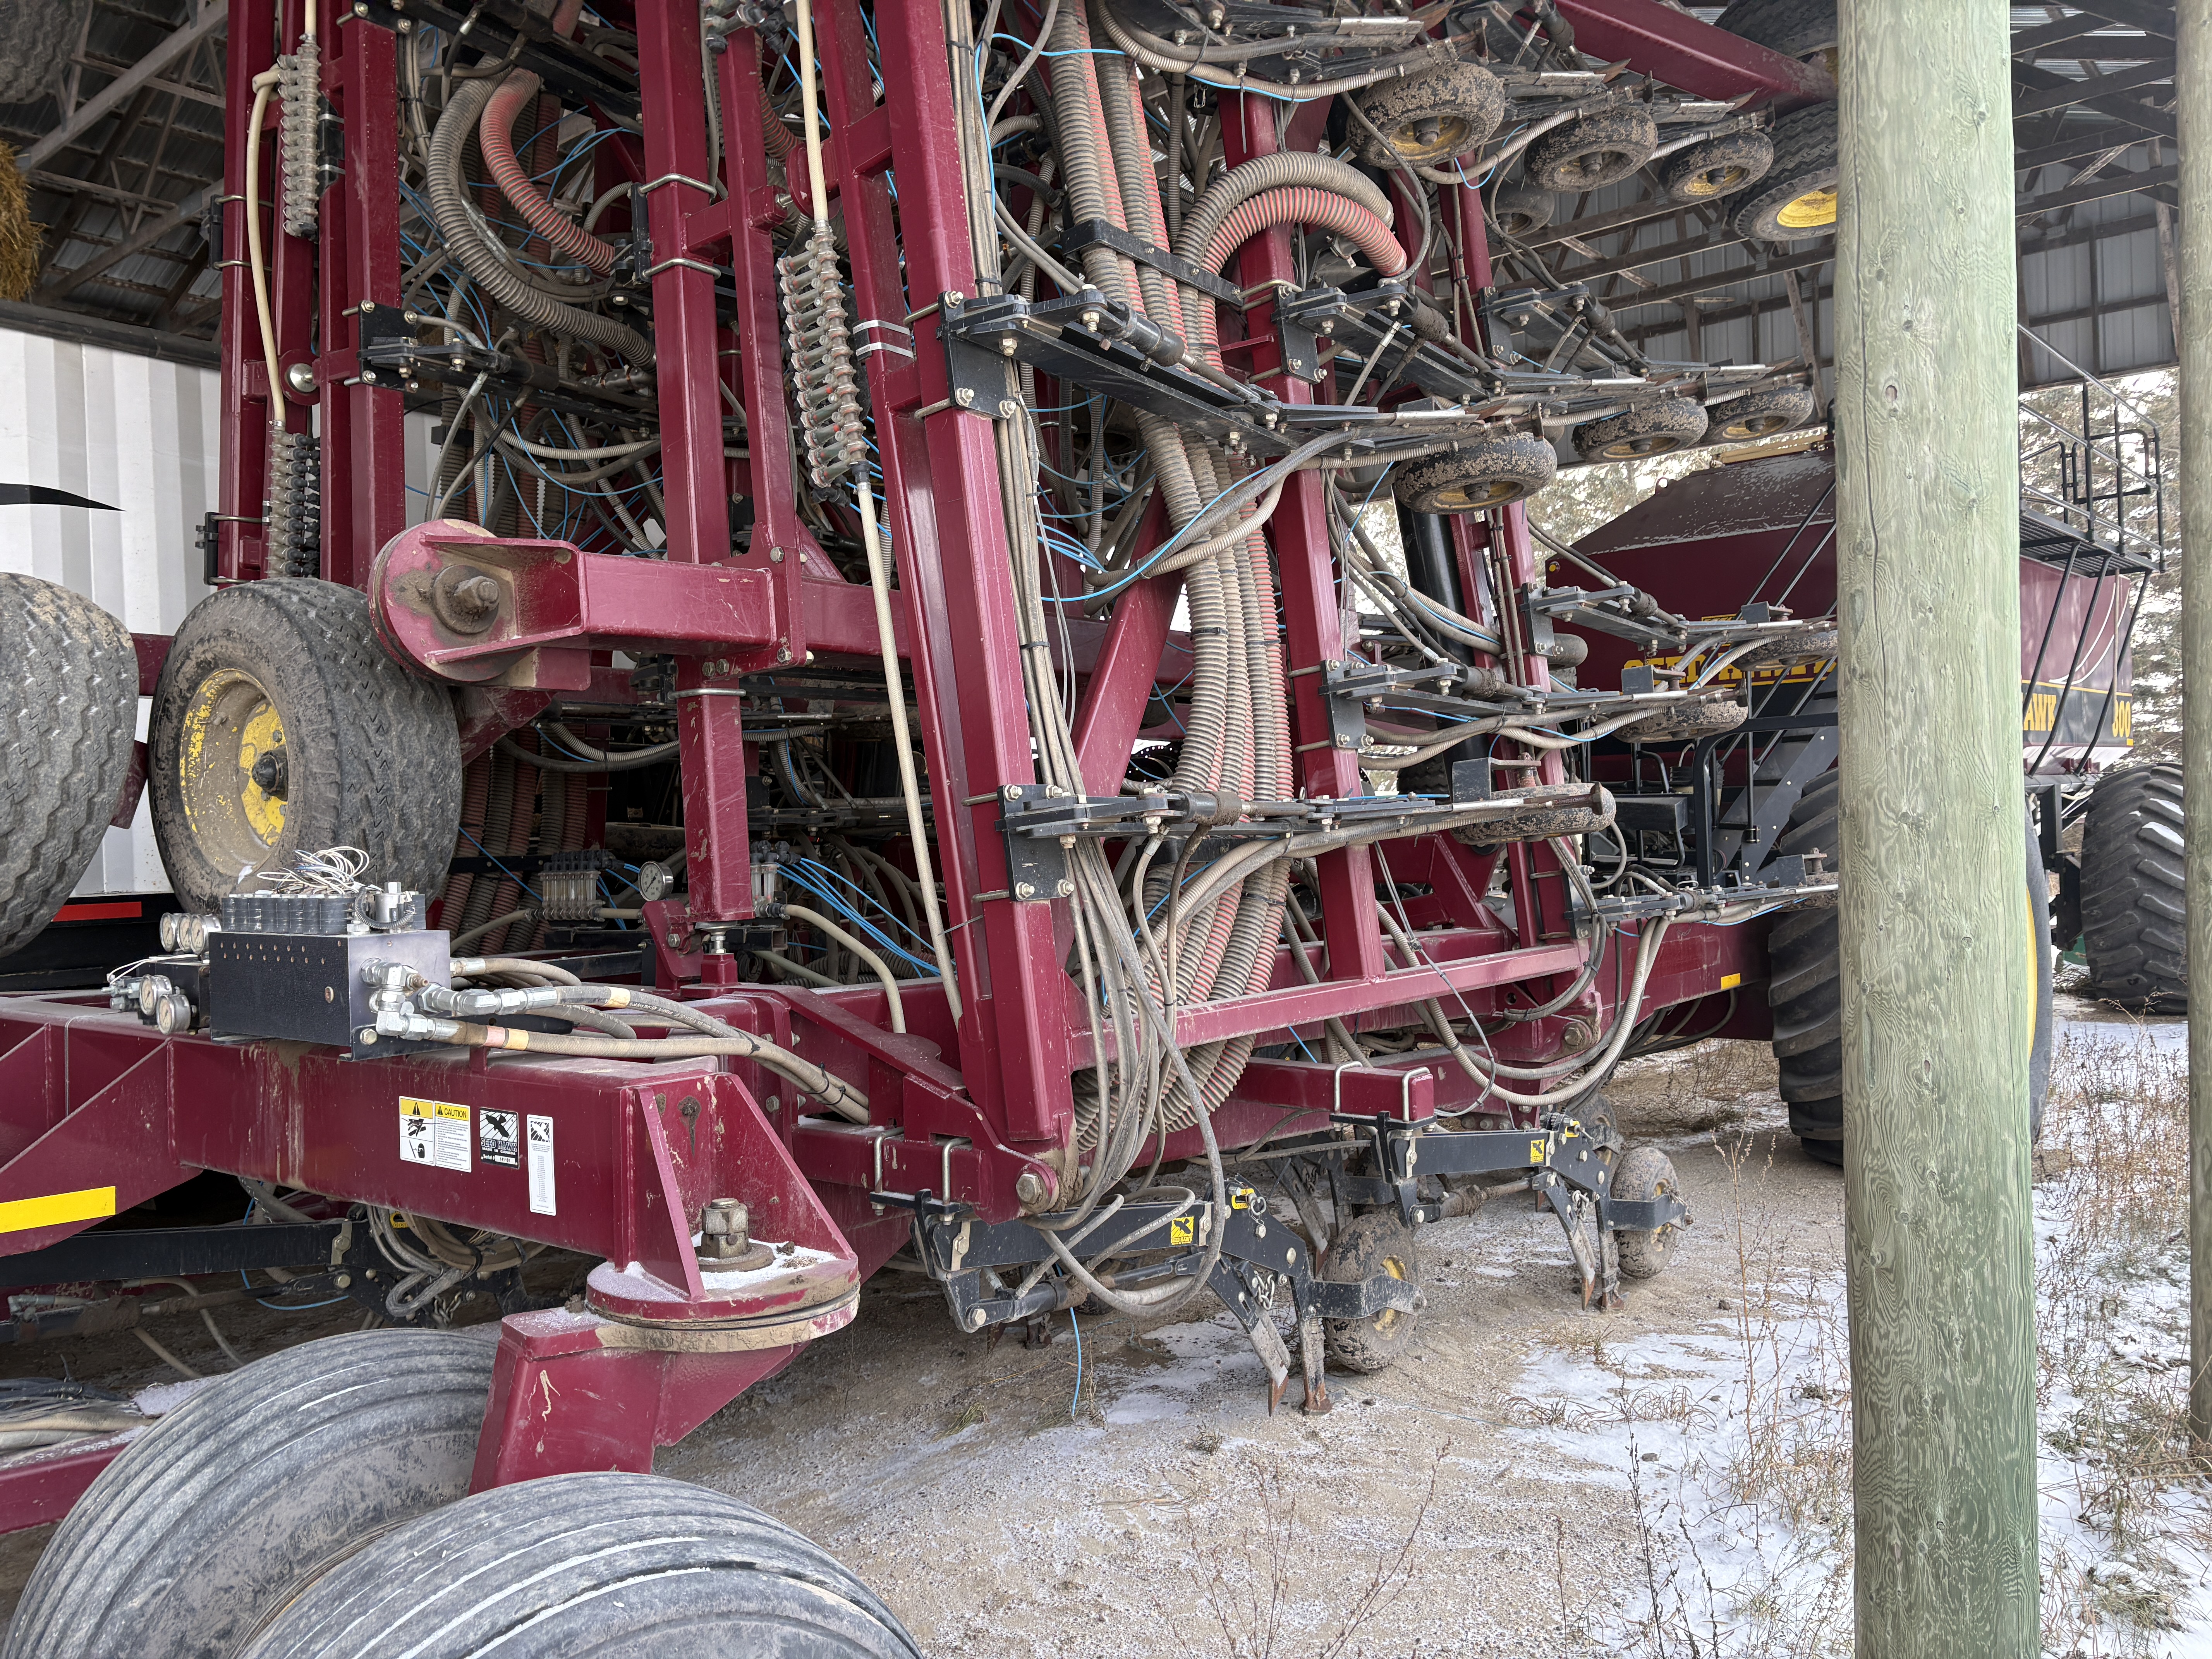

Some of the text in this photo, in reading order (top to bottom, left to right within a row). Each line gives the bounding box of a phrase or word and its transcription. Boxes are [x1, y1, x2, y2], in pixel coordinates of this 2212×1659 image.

[444, 1108, 467, 1118] CAUTION
[481, 1138, 517, 1152] SEED HAWK
